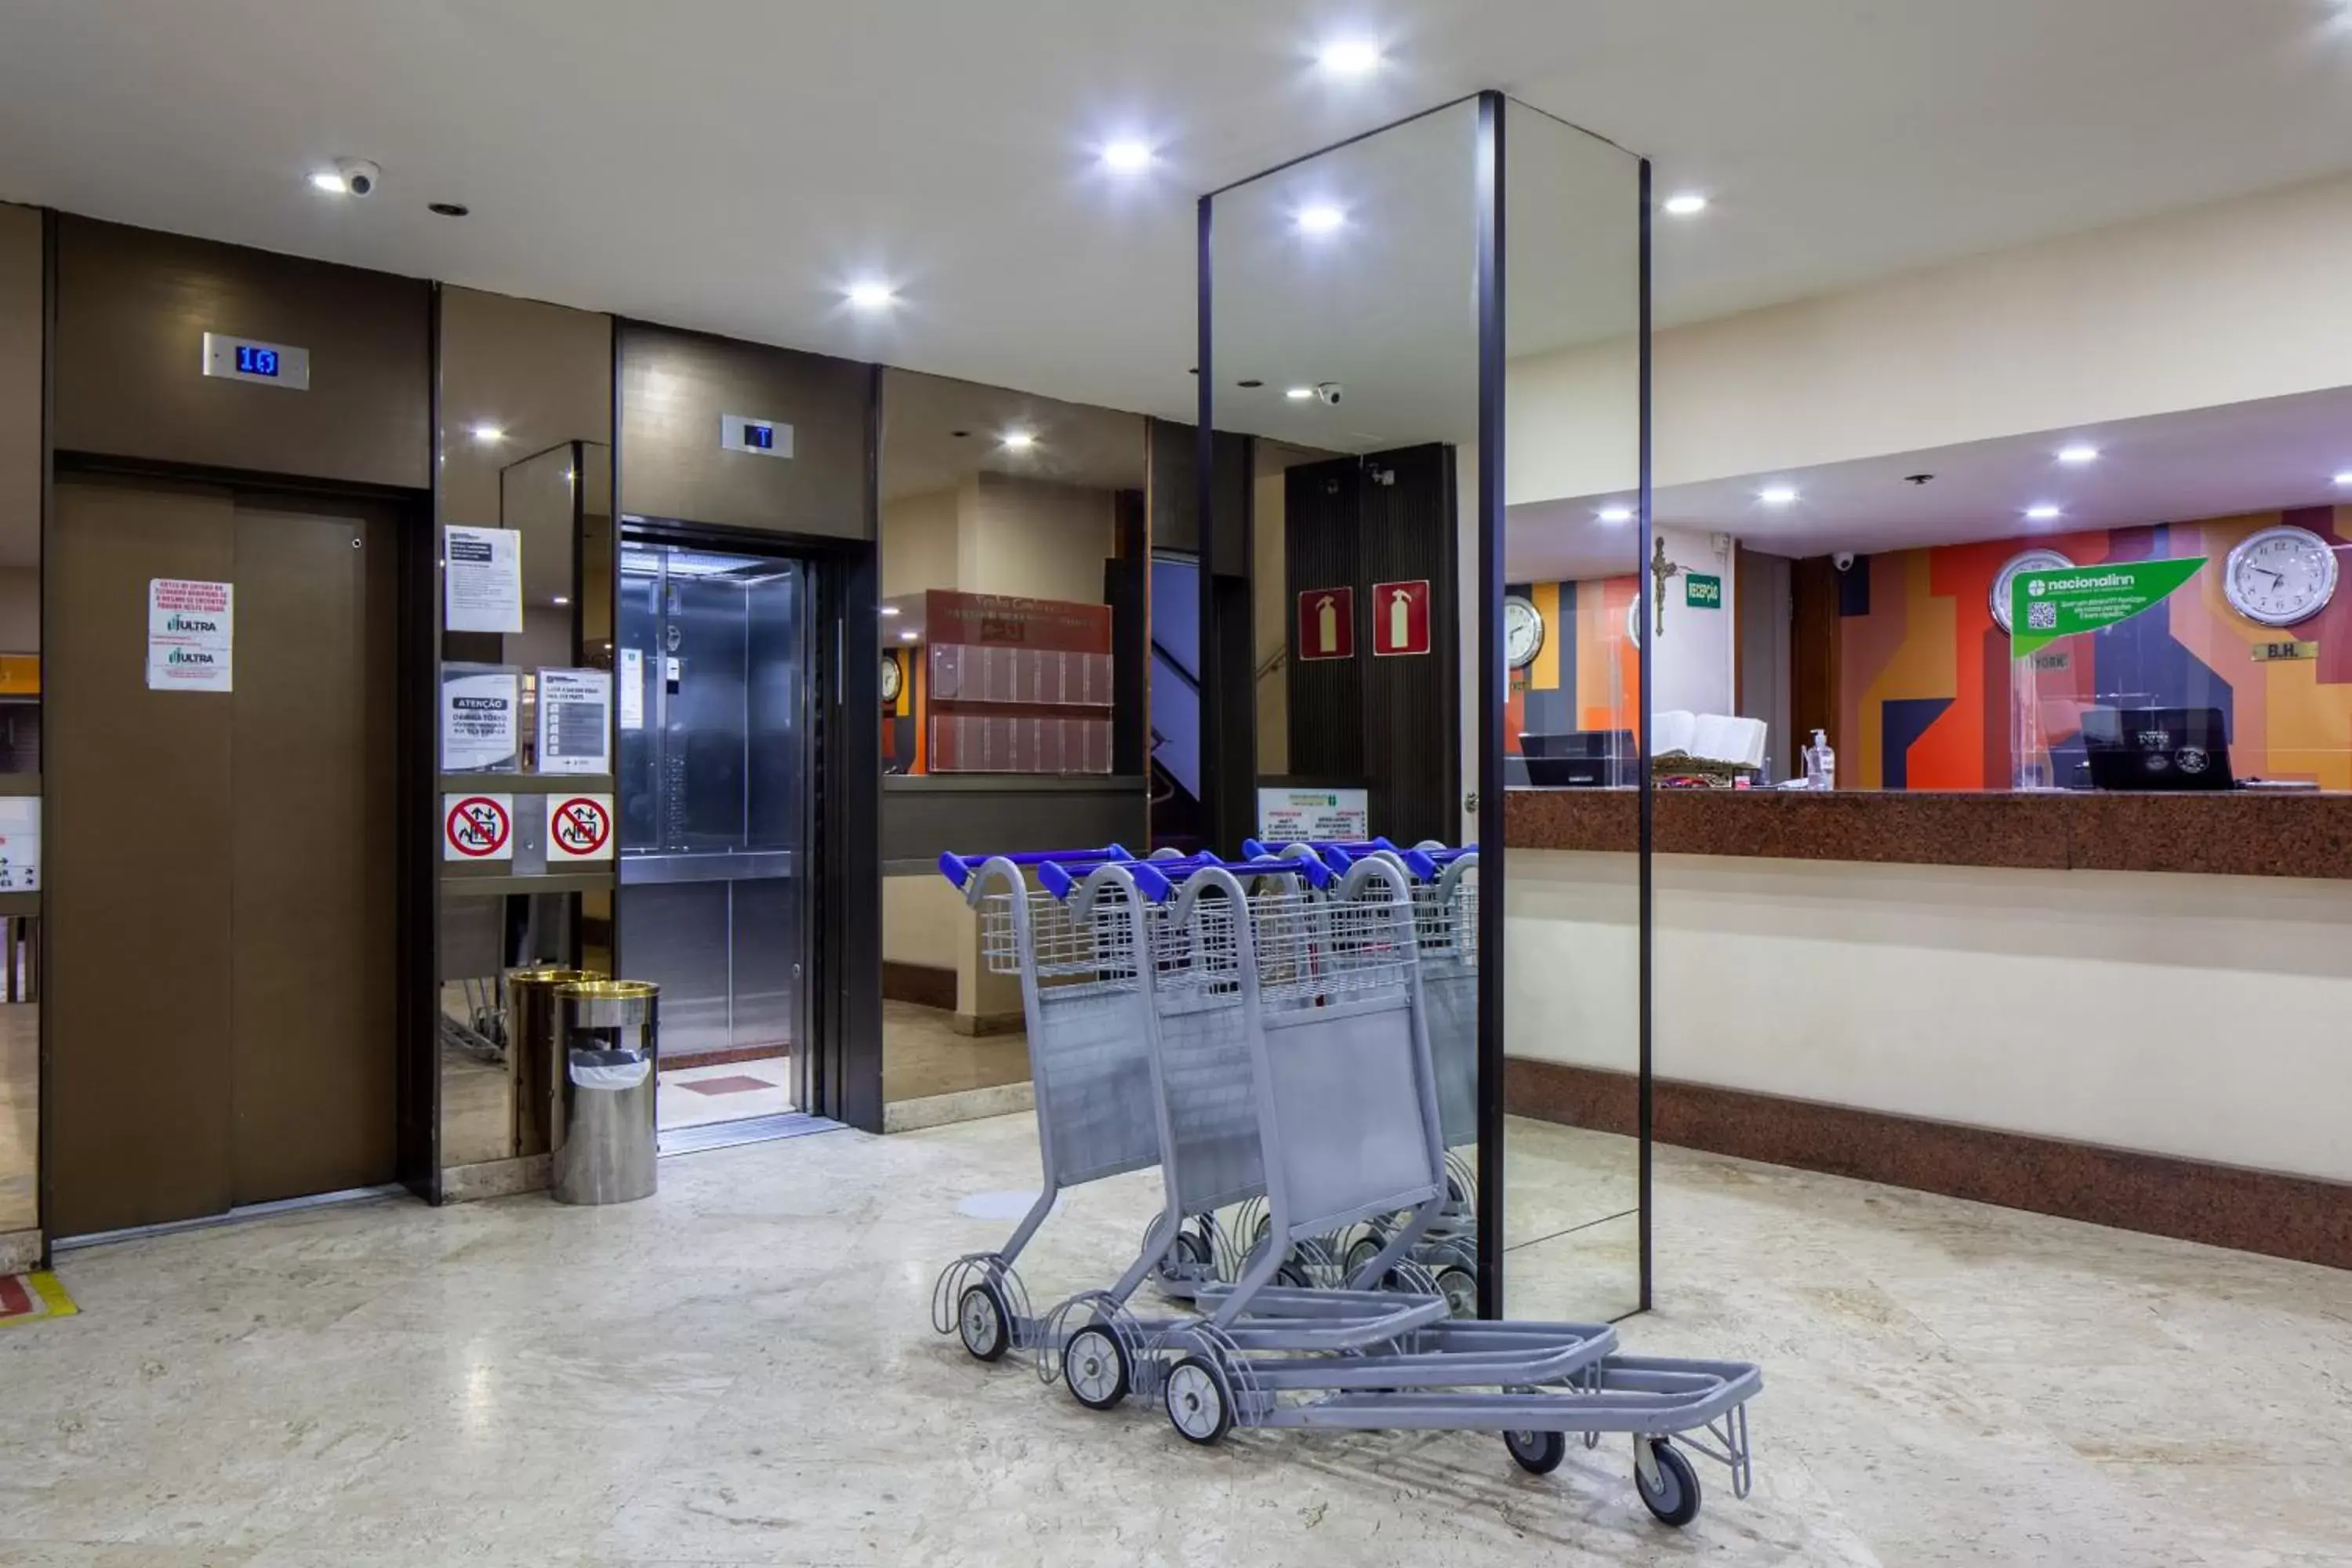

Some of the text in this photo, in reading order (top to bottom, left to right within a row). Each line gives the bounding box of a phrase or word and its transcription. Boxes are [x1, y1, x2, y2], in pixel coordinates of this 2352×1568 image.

[2048, 573, 2134, 590] nacionalinn
[180, 619, 216, 632] ULTRA
[2268, 643, 2298, 658] B.H.
[181, 652, 214, 664] ULTRA
[459, 699, 503, 709] ATENÇÃO
